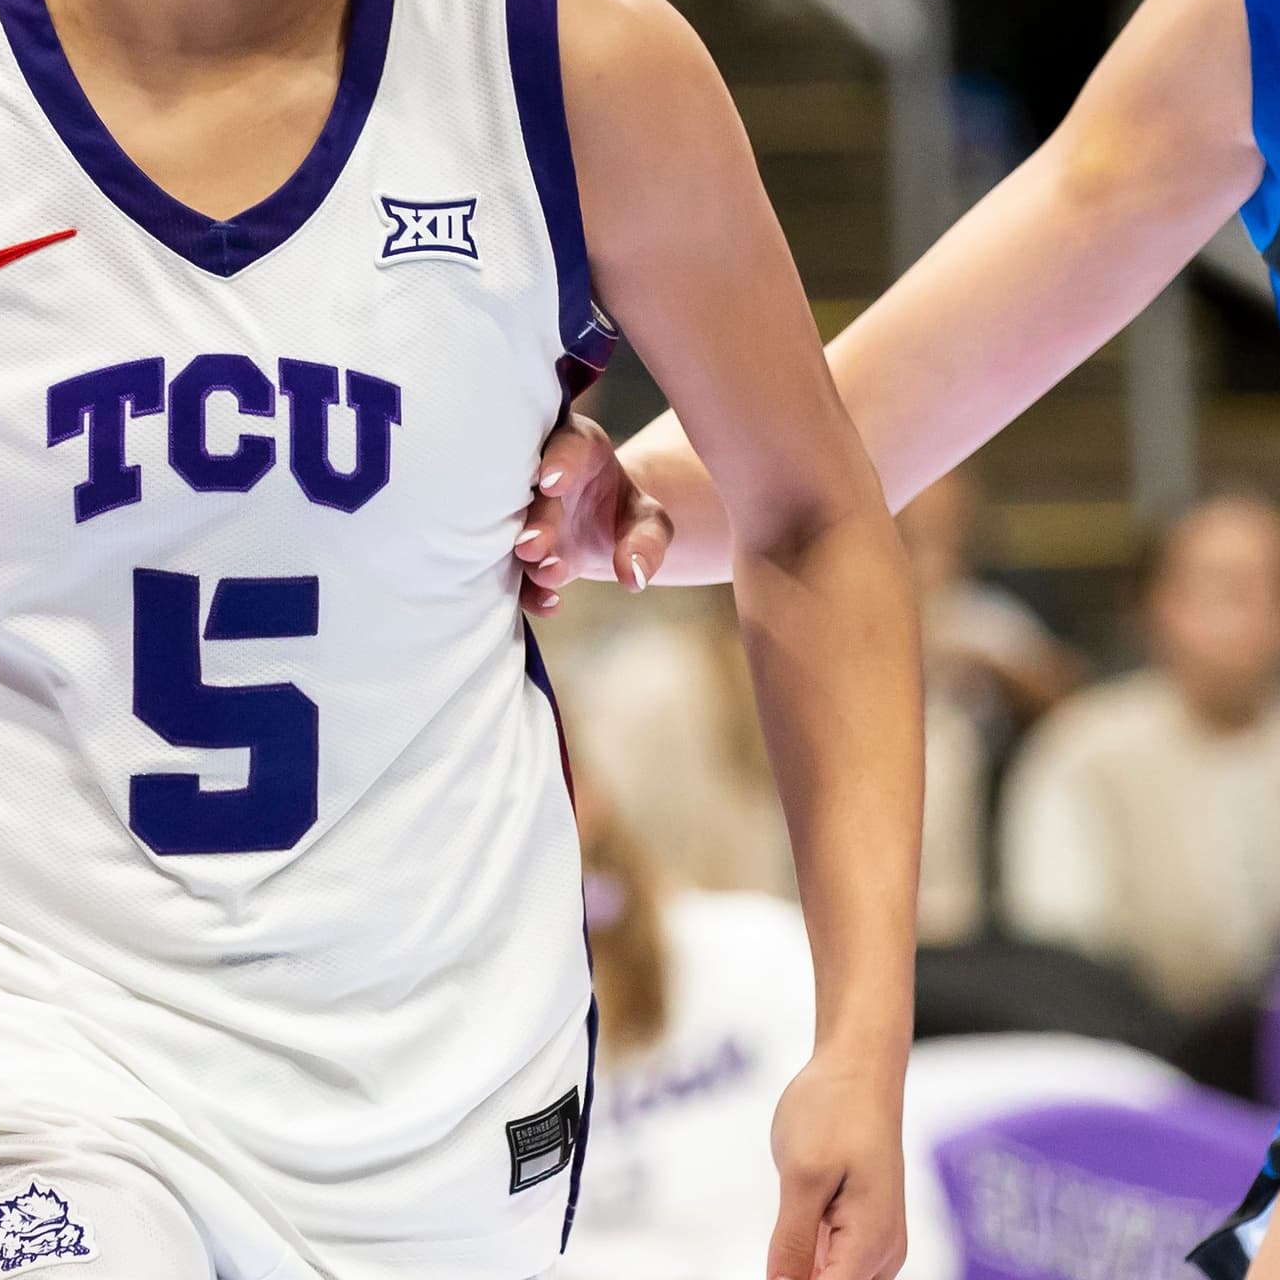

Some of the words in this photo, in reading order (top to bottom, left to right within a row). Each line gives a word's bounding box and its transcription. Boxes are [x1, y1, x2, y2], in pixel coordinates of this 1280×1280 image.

[382, 198, 477, 259] XII
[47, 354, 402, 523] TCU
[129, 567, 319, 856] 5
